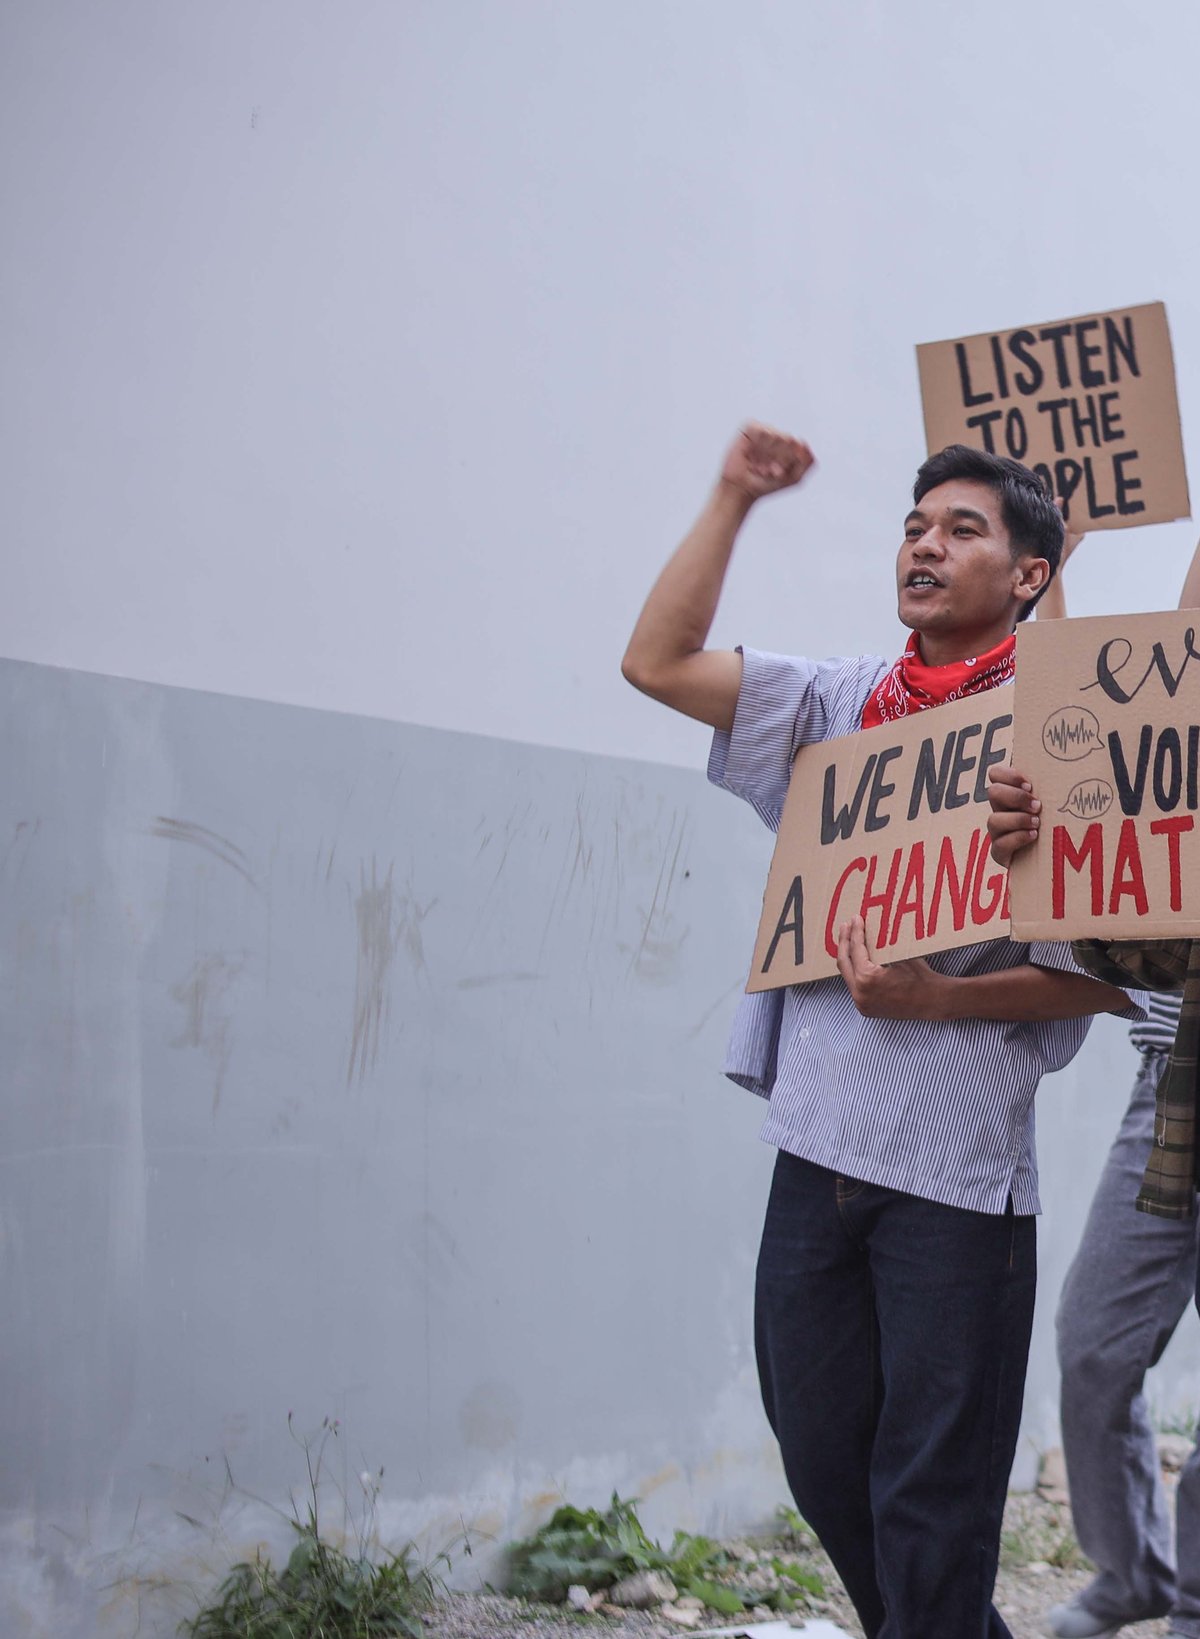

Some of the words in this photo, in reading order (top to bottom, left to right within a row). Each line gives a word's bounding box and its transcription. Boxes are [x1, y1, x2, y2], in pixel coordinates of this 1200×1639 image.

[955, 315, 1141, 408] LISTEN
[967, 407, 1028, 460] TO
[1038, 391, 1125, 453] THE
[1033, 449, 1146, 520] PLE
[820, 745, 903, 846] WE
[907, 714, 1013, 821] NEE
[761, 875, 804, 974] A
[824, 828, 1011, 959] CHANG
